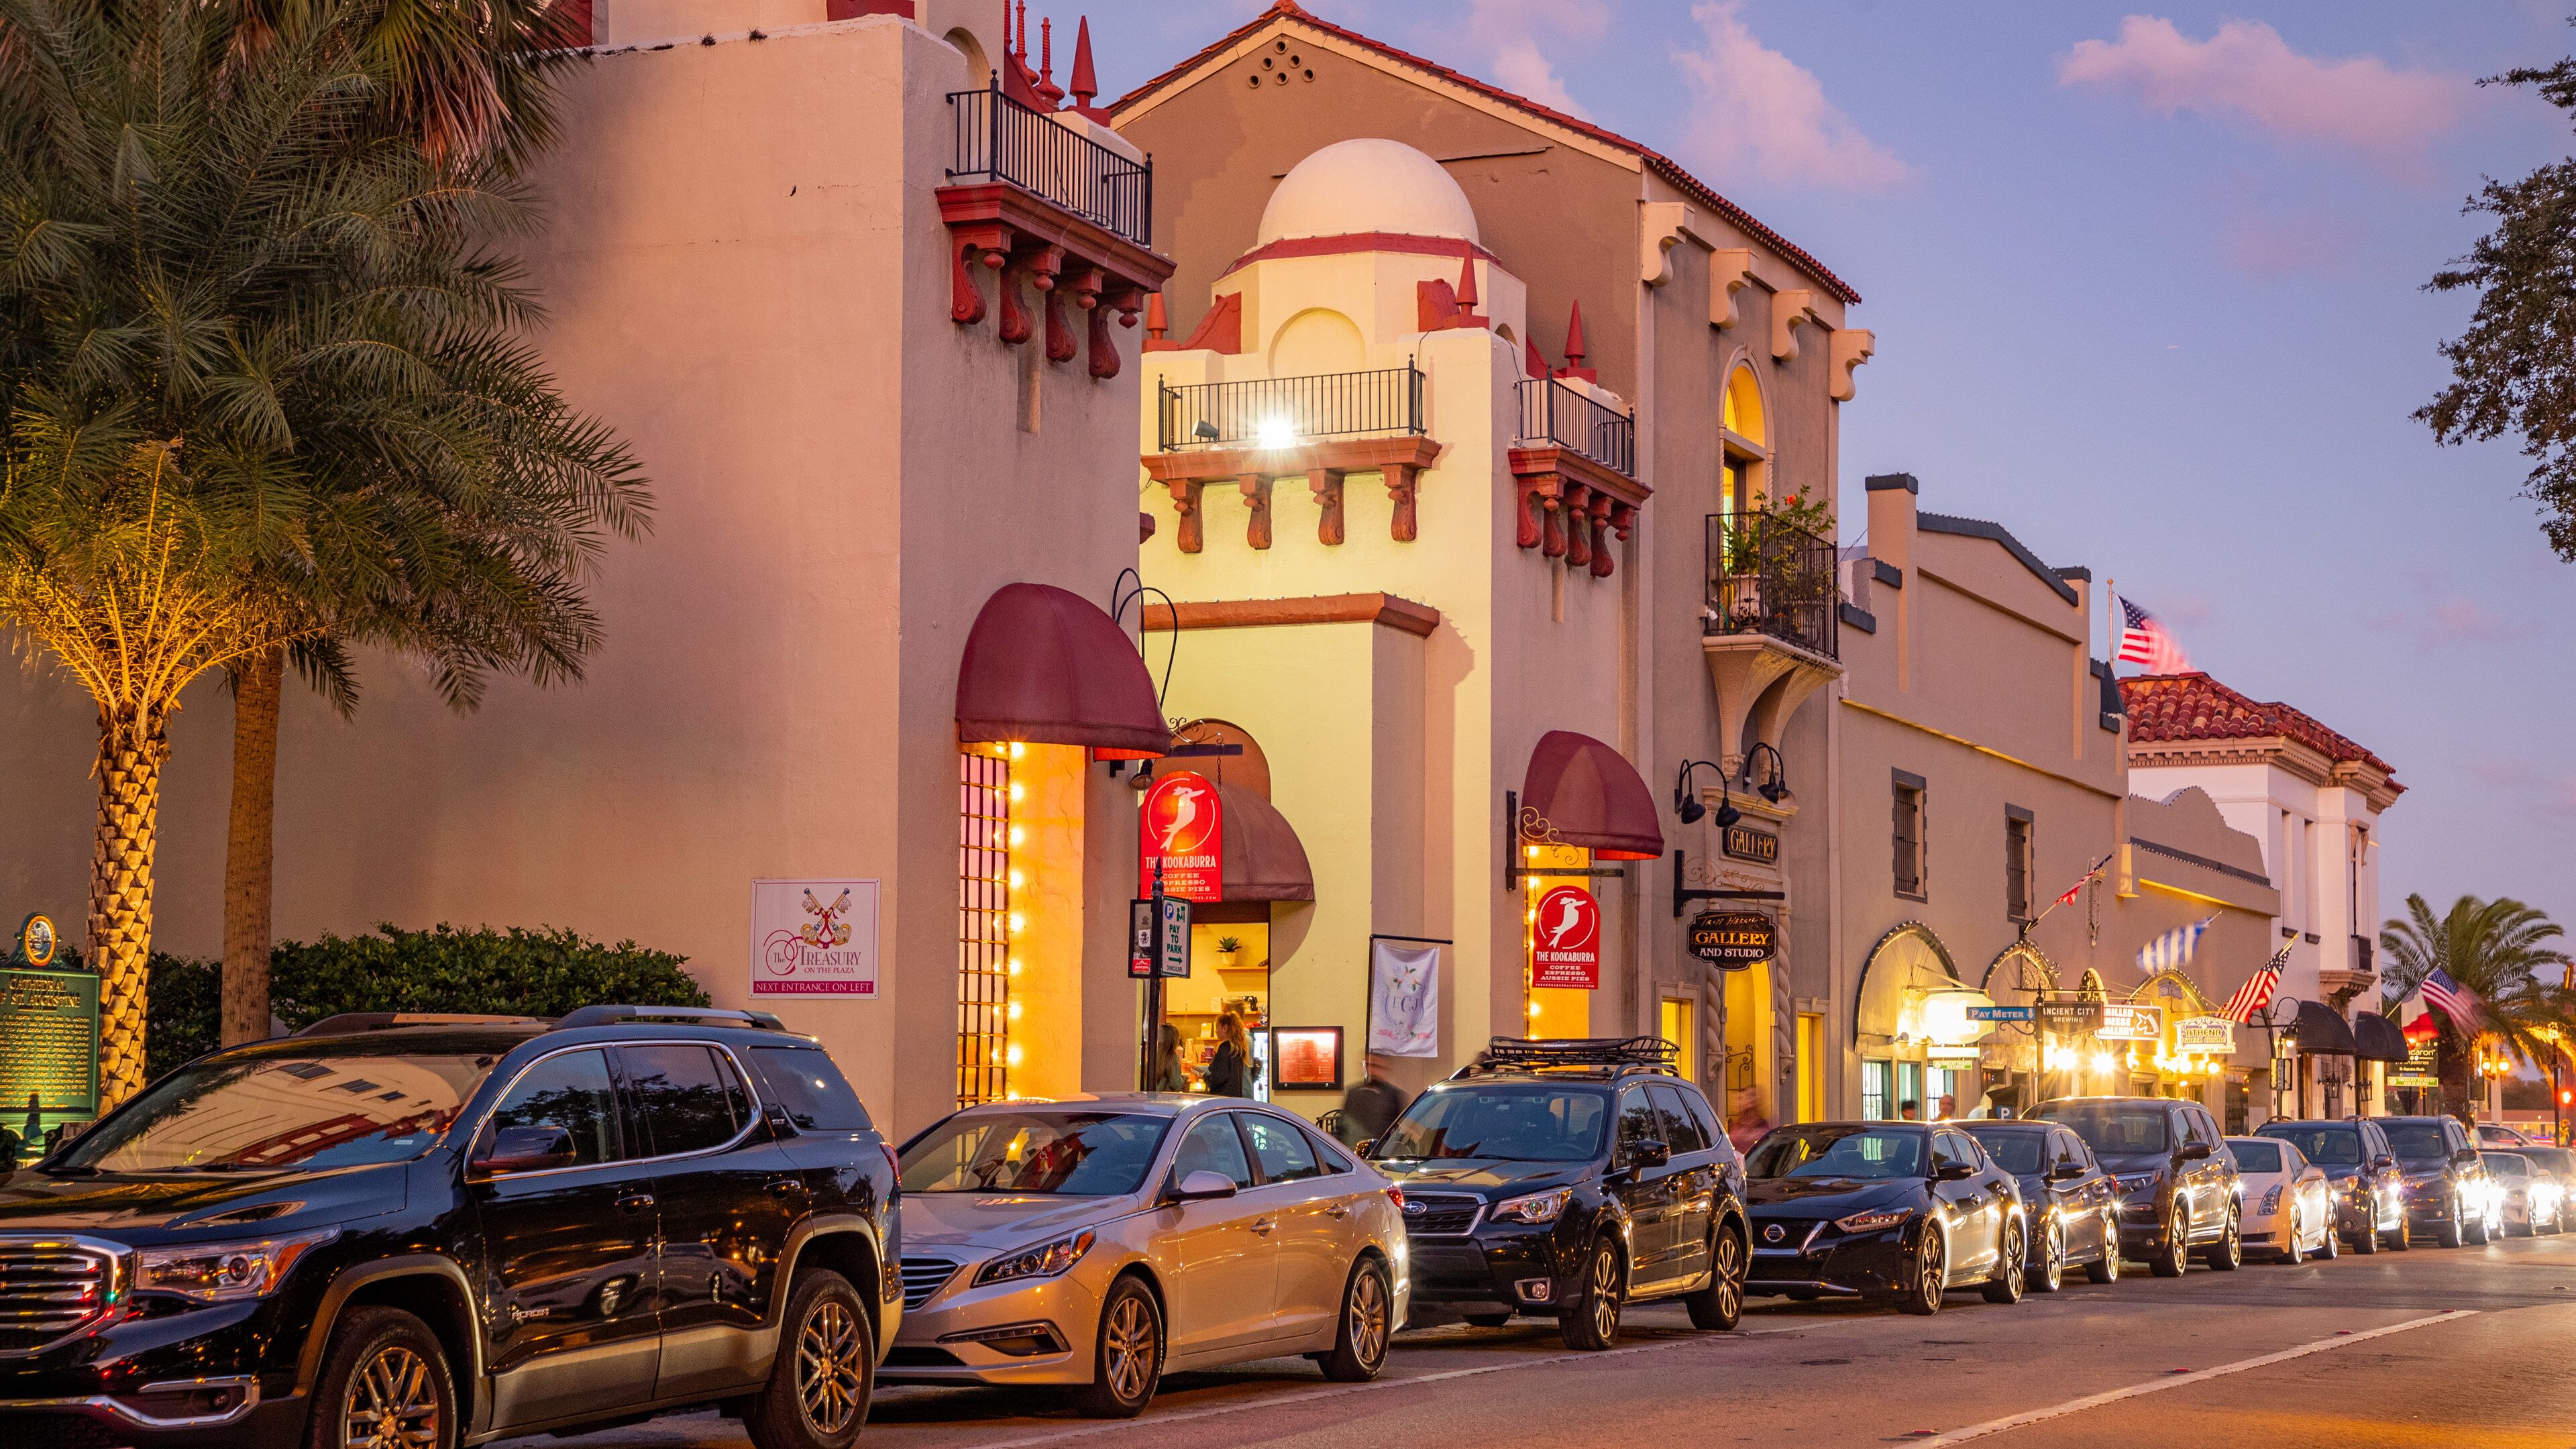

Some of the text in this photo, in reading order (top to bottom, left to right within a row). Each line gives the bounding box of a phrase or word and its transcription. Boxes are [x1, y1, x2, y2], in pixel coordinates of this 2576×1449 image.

[1731, 829, 1776, 859] GALLERY
[1163, 855, 1216, 869] KOOKABURRA
[1169, 924, 1181, 934] PAY
[1171, 934, 1179, 944] TO
[1695, 932, 1770, 945] GALLERY
[1167, 944, 1182, 954] PARK
[1699, 948, 1764, 957] AND STUDIO
[773, 946, 862, 966] The TREASURY
[1536, 951, 1595, 963] THE KOOKABURRA
[9, 978, 66, 992] CATHEDRAL
[756, 983, 871, 991] NEXT ENTRANCE ON LEFT
[28, 994, 80, 1008] AUGUSTINE
[1992, 1010, 2024, 1018] METER
[2077, 1008, 2096, 1016] CITY
[2104, 1008, 2134, 1017] RILLED
[2186, 1028, 2222, 1036] ATHENA
